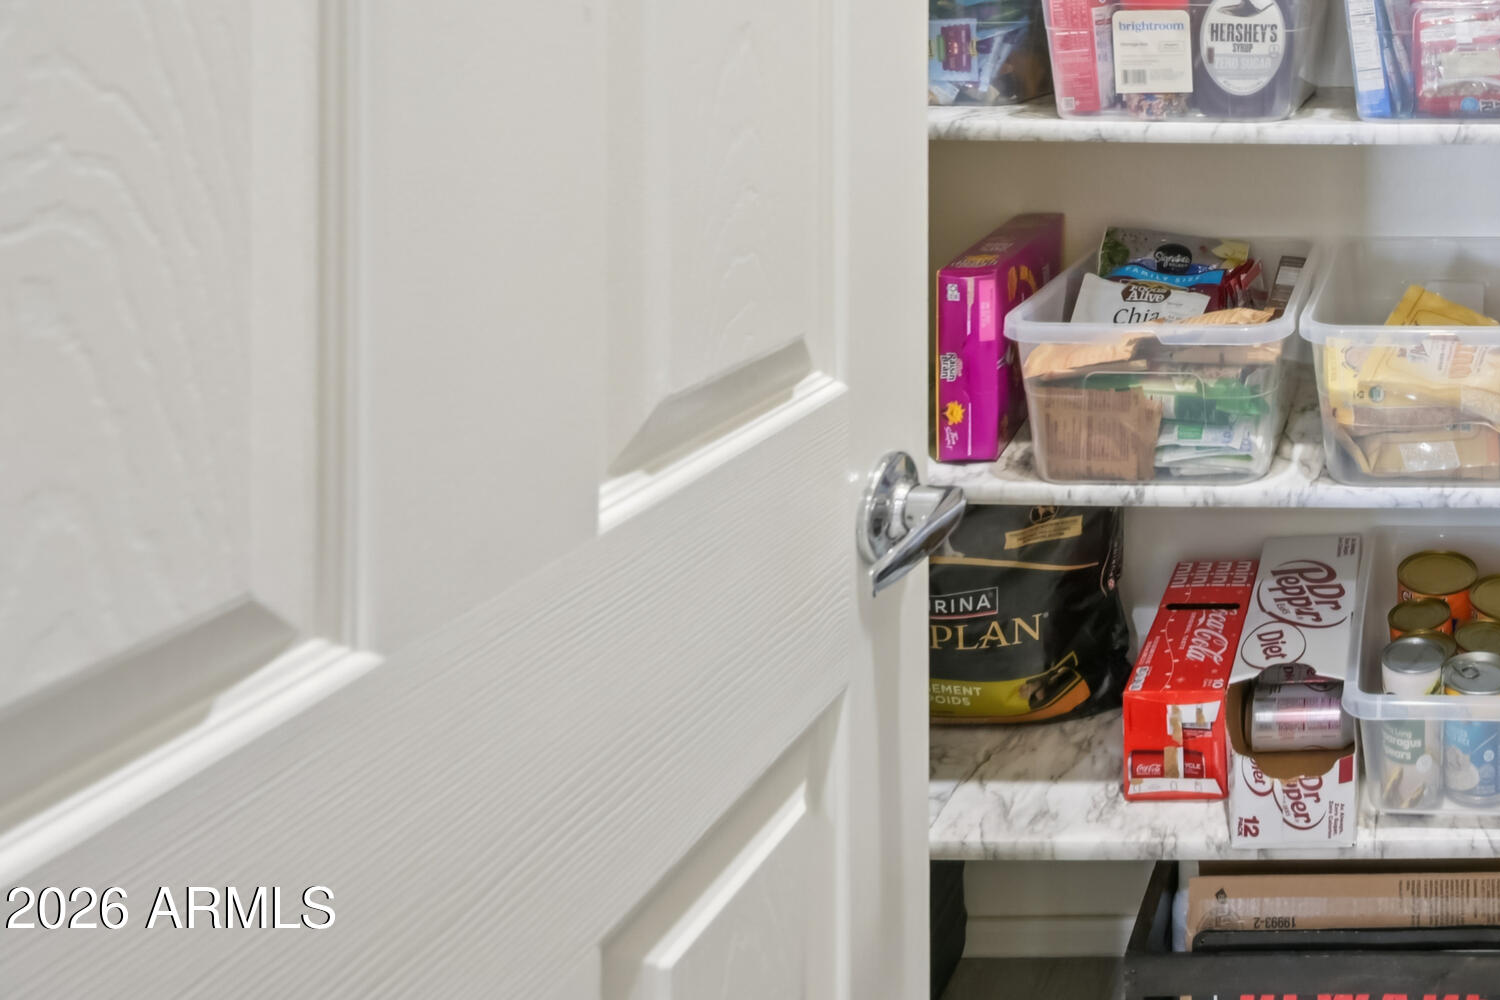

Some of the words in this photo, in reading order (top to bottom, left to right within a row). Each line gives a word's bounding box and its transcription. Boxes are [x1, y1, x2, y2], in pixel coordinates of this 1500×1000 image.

[1118, 21, 1185, 33] brightroom
[1210, 22, 1279, 43] HERSHEY'S
[1231, 43, 1254, 53] SYRUP
[1124, 265, 1169, 281] FAMILY
[1112, 306, 1161, 324] Chia
[1169, 562, 1194, 589] mini
[1190, 562, 1212, 588] mini
[1211, 561, 1233, 588] mini
[1231, 561, 1254, 588] mini
[934, 594, 992, 614] RINA
[1305, 583, 1346, 611] Dr
[930, 612, 1045, 650] PLAN
[1256, 629, 1287, 660] Diet
[929, 683, 982, 697] EMENT
[1184, 762, 1202, 770] YCLE
[1299, 776, 1324, 804] Dr
[1285, 781, 1312, 825] pper
[1243, 815, 1260, 838] 12
[1253, 916, 1297, 929] 19993-2
